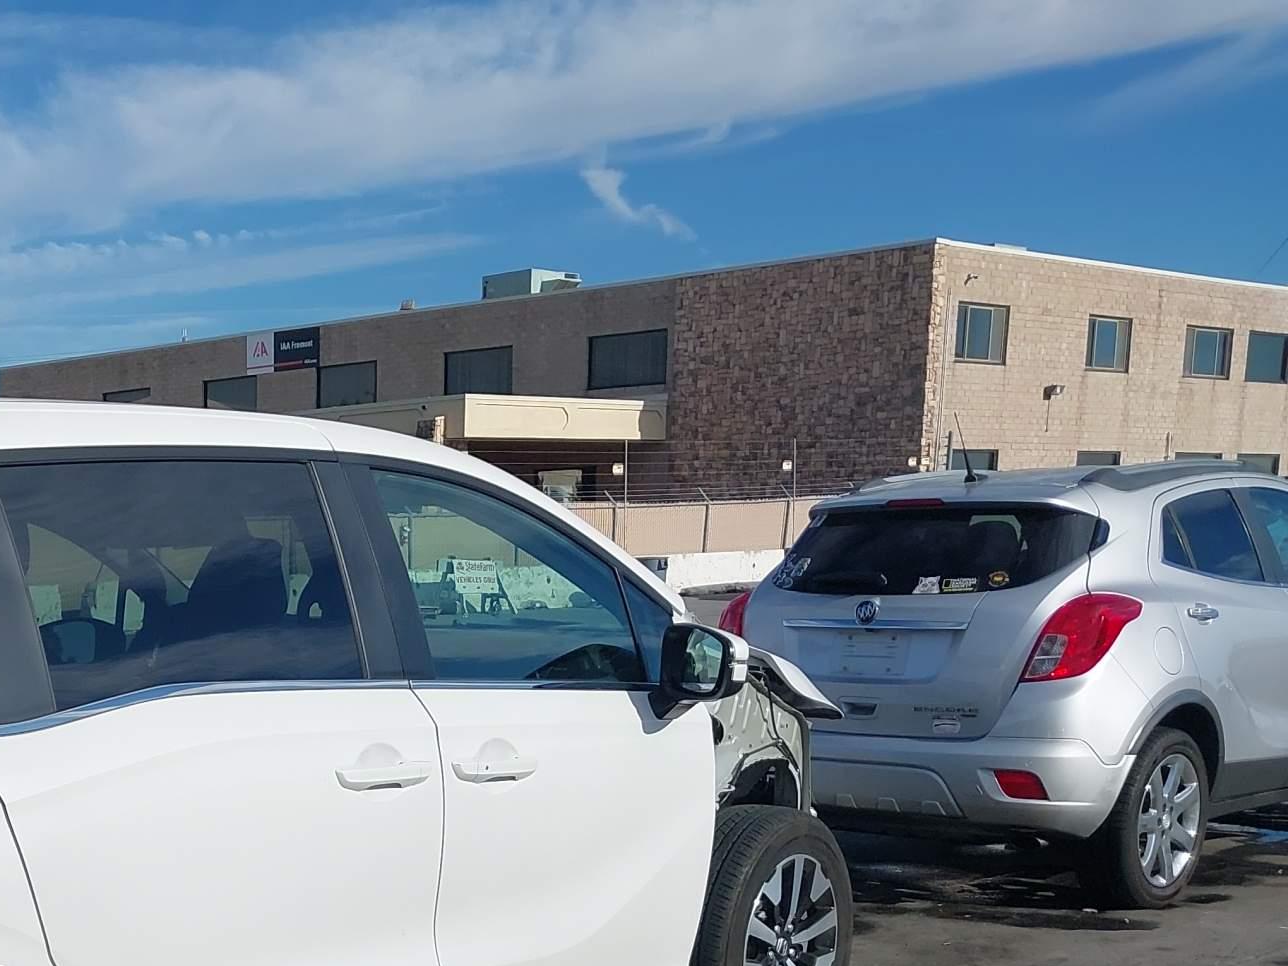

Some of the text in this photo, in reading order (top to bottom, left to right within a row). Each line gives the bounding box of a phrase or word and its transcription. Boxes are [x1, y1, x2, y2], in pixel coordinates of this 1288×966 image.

[280, 340, 313, 351] IAA Fremont
[456, 576, 496, 584] VEHICLES ONLY
